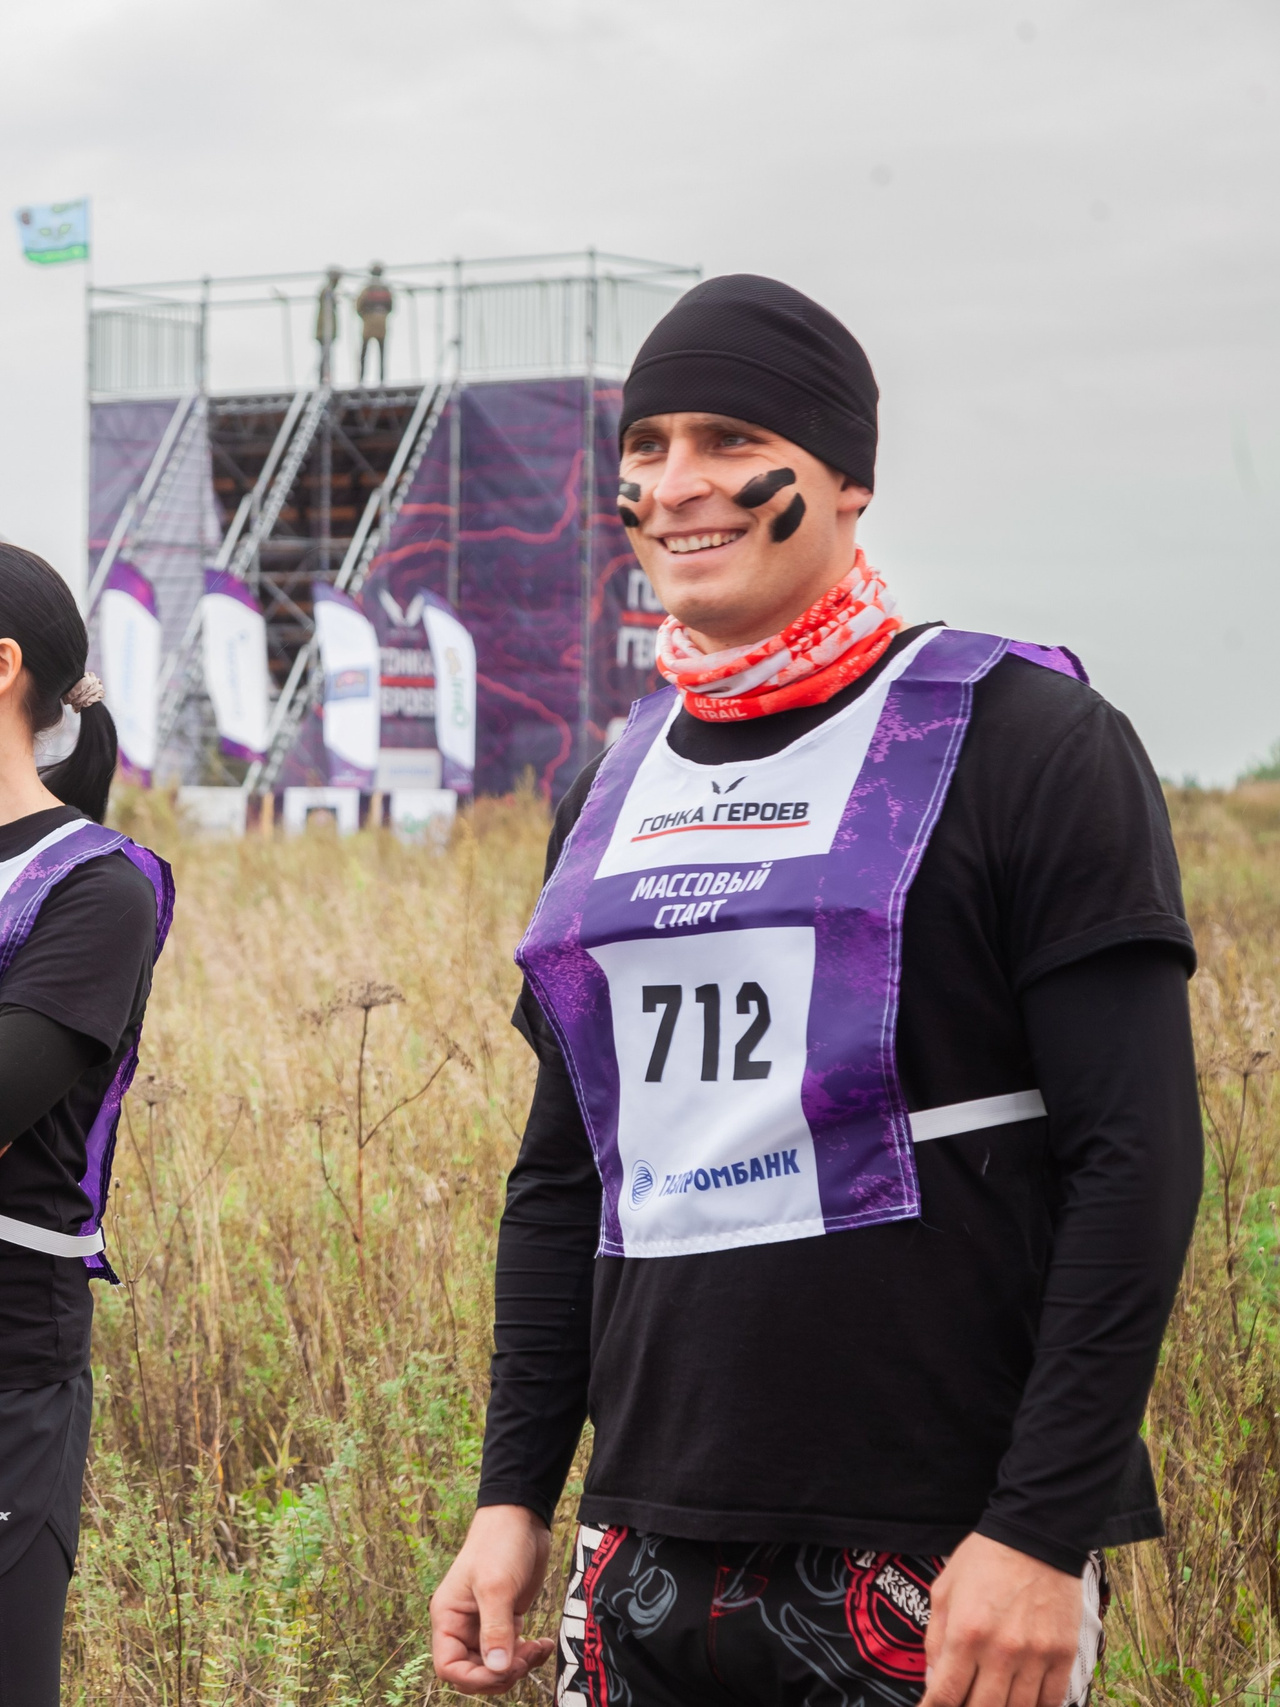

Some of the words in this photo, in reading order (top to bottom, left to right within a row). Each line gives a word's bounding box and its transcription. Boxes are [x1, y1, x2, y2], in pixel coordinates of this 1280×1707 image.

[698, 707, 748, 719] TRAIL
[639, 806, 705, 834] ГОНКА
[712, 802, 810, 822] ГЕРОЕВ
[630, 862, 774, 902] МАССОВЫЙ
[653, 899, 728, 930] СТАРТ
[642, 981, 773, 1083] 712
